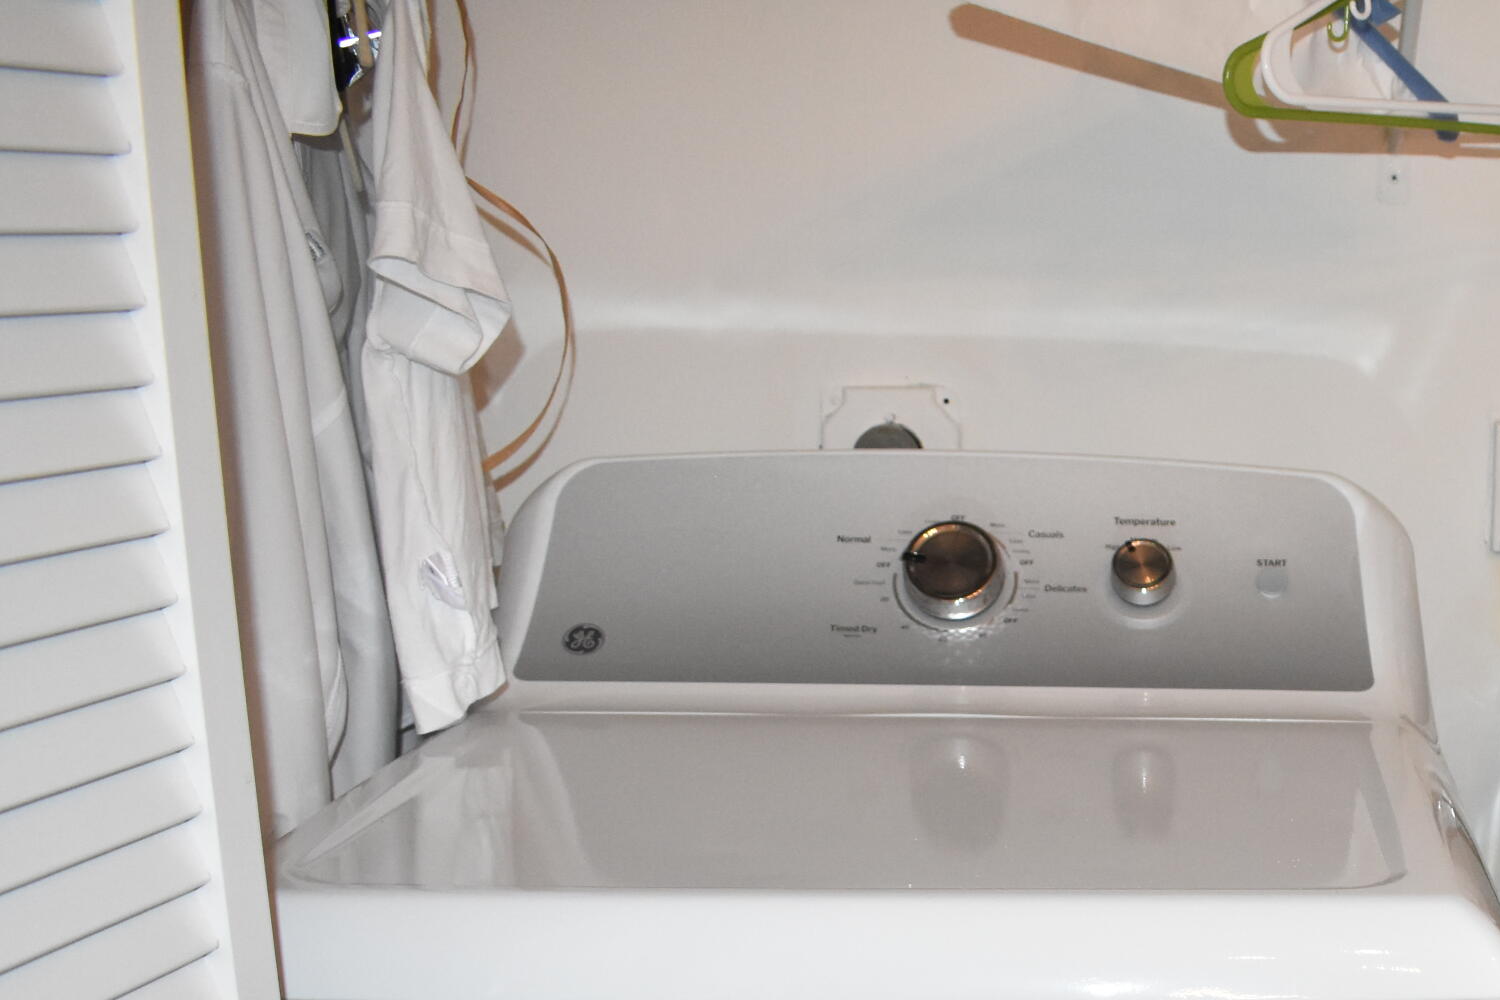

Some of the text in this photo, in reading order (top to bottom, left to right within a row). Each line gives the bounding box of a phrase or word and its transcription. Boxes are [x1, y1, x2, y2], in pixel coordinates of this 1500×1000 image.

[1114, 516, 1176, 527] Temperature
[1028, 529, 1065, 539] Casuals
[836, 535, 872, 544] Normal
[1256, 558, 1287, 568] START
[1044, 584, 1088, 593] Delicates
[831, 624, 878, 635] Timed Dry
